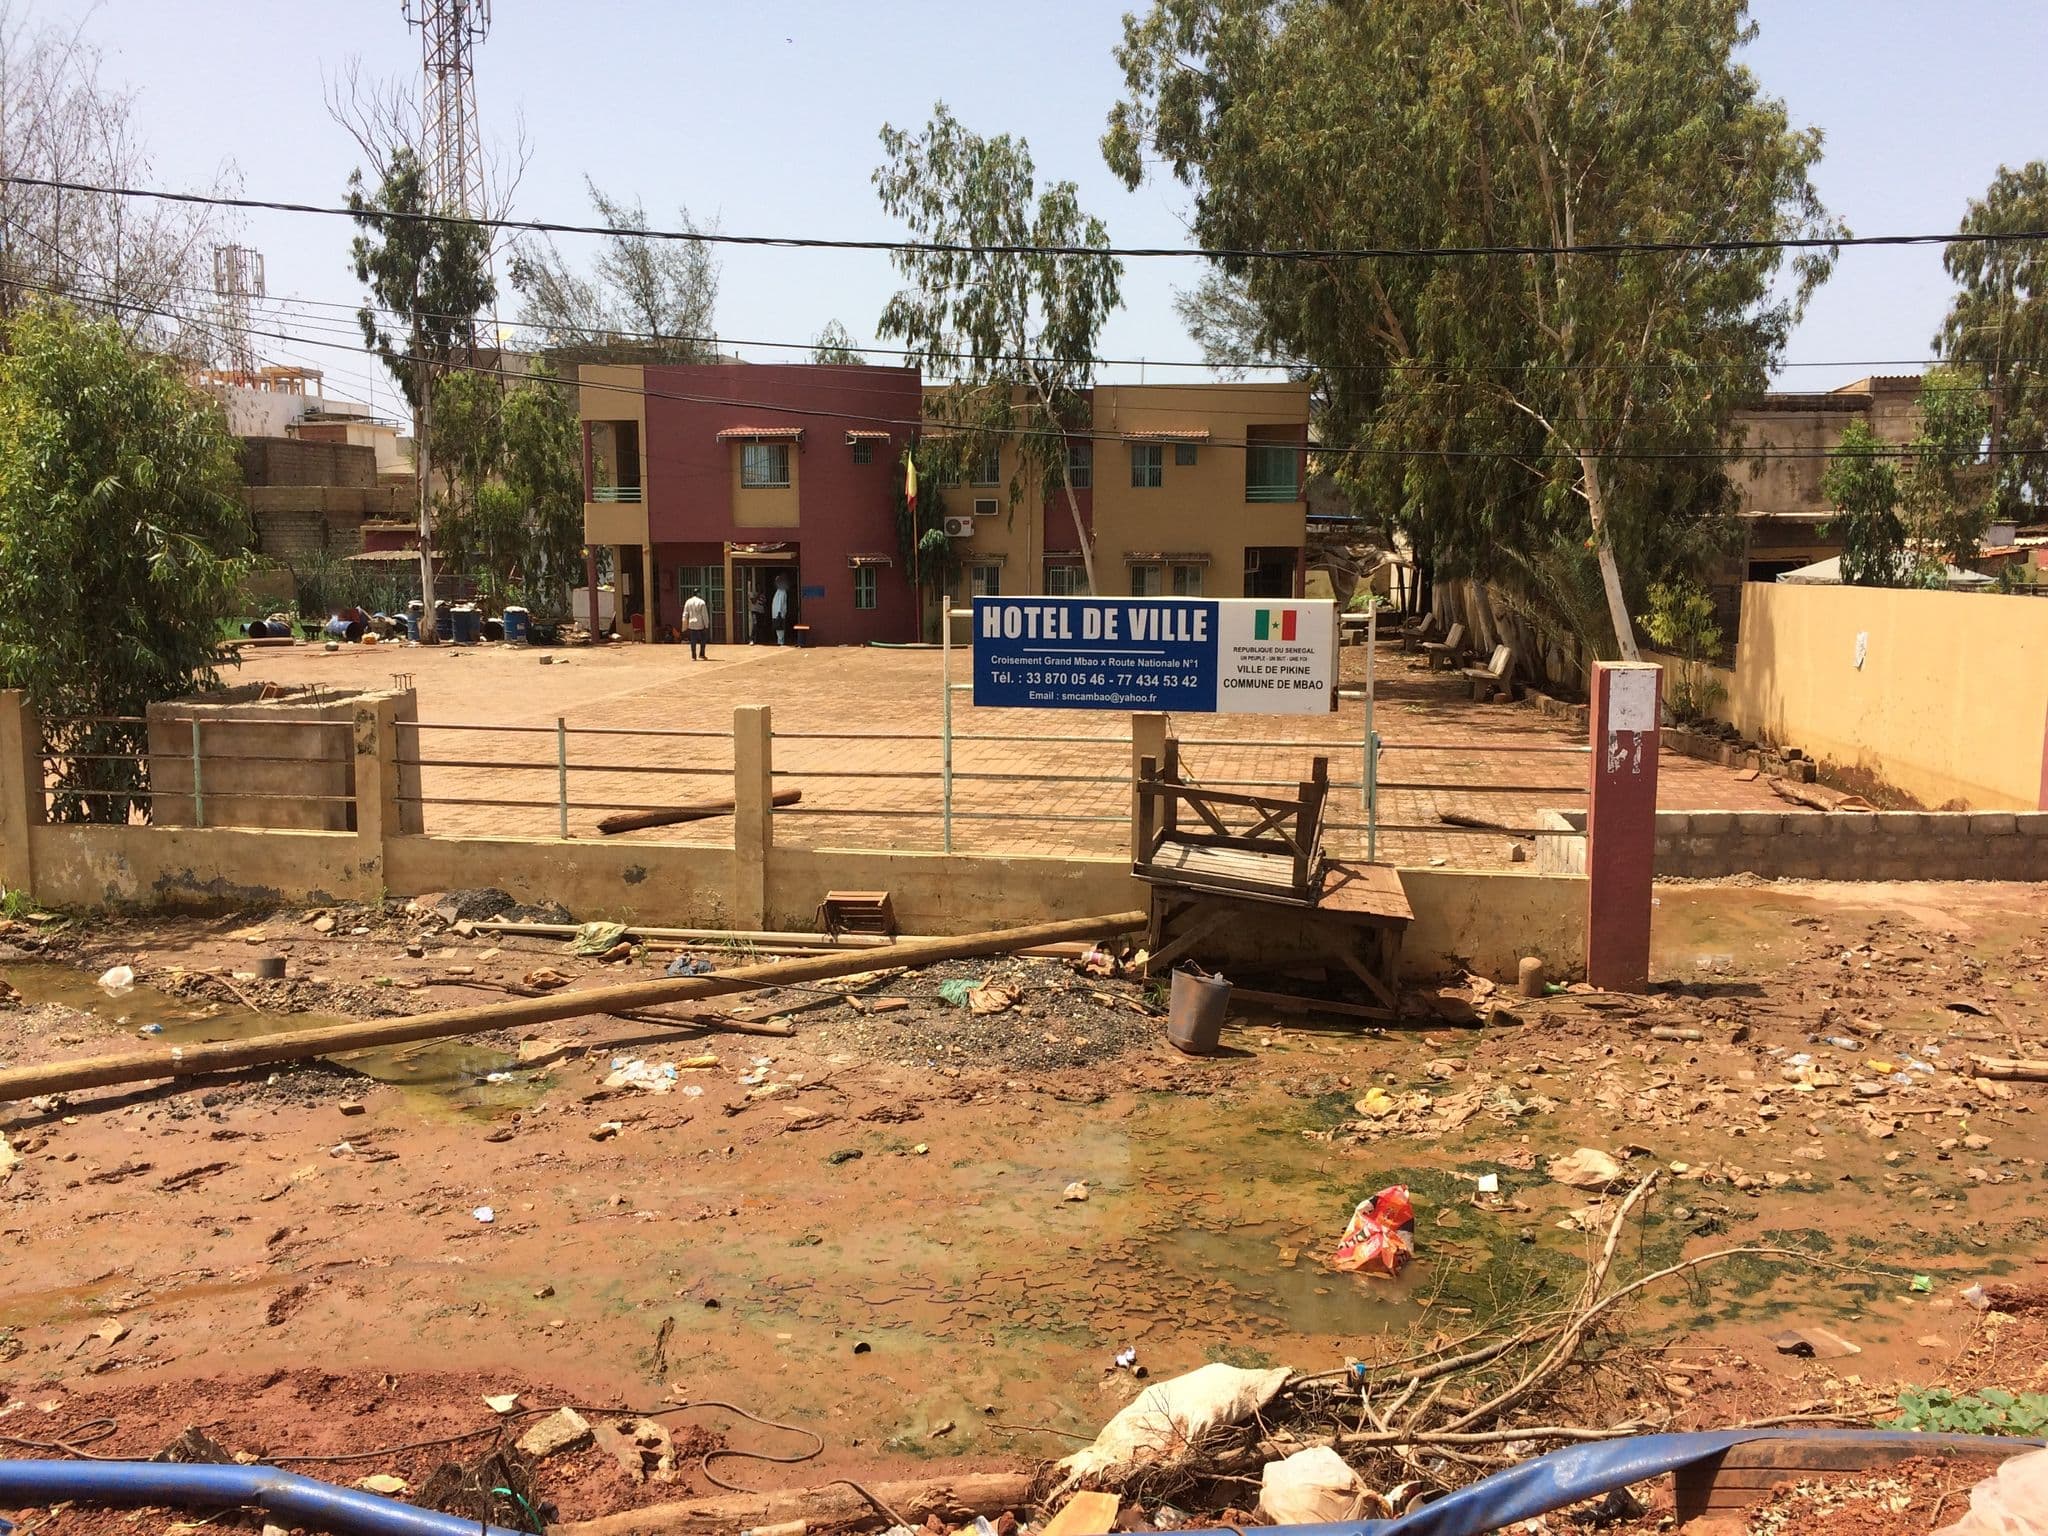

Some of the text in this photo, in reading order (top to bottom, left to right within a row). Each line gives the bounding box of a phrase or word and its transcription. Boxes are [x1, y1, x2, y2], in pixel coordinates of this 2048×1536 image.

[982, 606, 1208, 642] HOTEL DE VILLE
[991, 655, 1042, 665] Croisement
[1044, 656, 1072, 666] Grand
[1074, 657, 1099, 666] Mbao
[1108, 658, 1136, 667] Route
[1138, 658, 1181, 668] Nationale
[1182, 659, 1199, 668] N°1
[1237, 665, 1311, 674] VILLE DE PIKINE
[991, 671, 1015, 684] Tél.
[1026, 672, 1041, 684] 33
[1044, 673, 1068, 685] 870
[1071, 673, 1087, 685] 05
[1089, 674, 1106, 685] 46
[1117, 674, 1133, 686] 77
[1135, 675, 1160, 687] 434
[1163, 675, 1178, 687] 53
[1181, 676, 1198, 687] 42
[1223, 678, 1324, 690] COMMUNE DE MBAO
[1029, 691, 1054, 700] Email
[1062, 691, 1158, 704] smcambao@yahoo.fr
